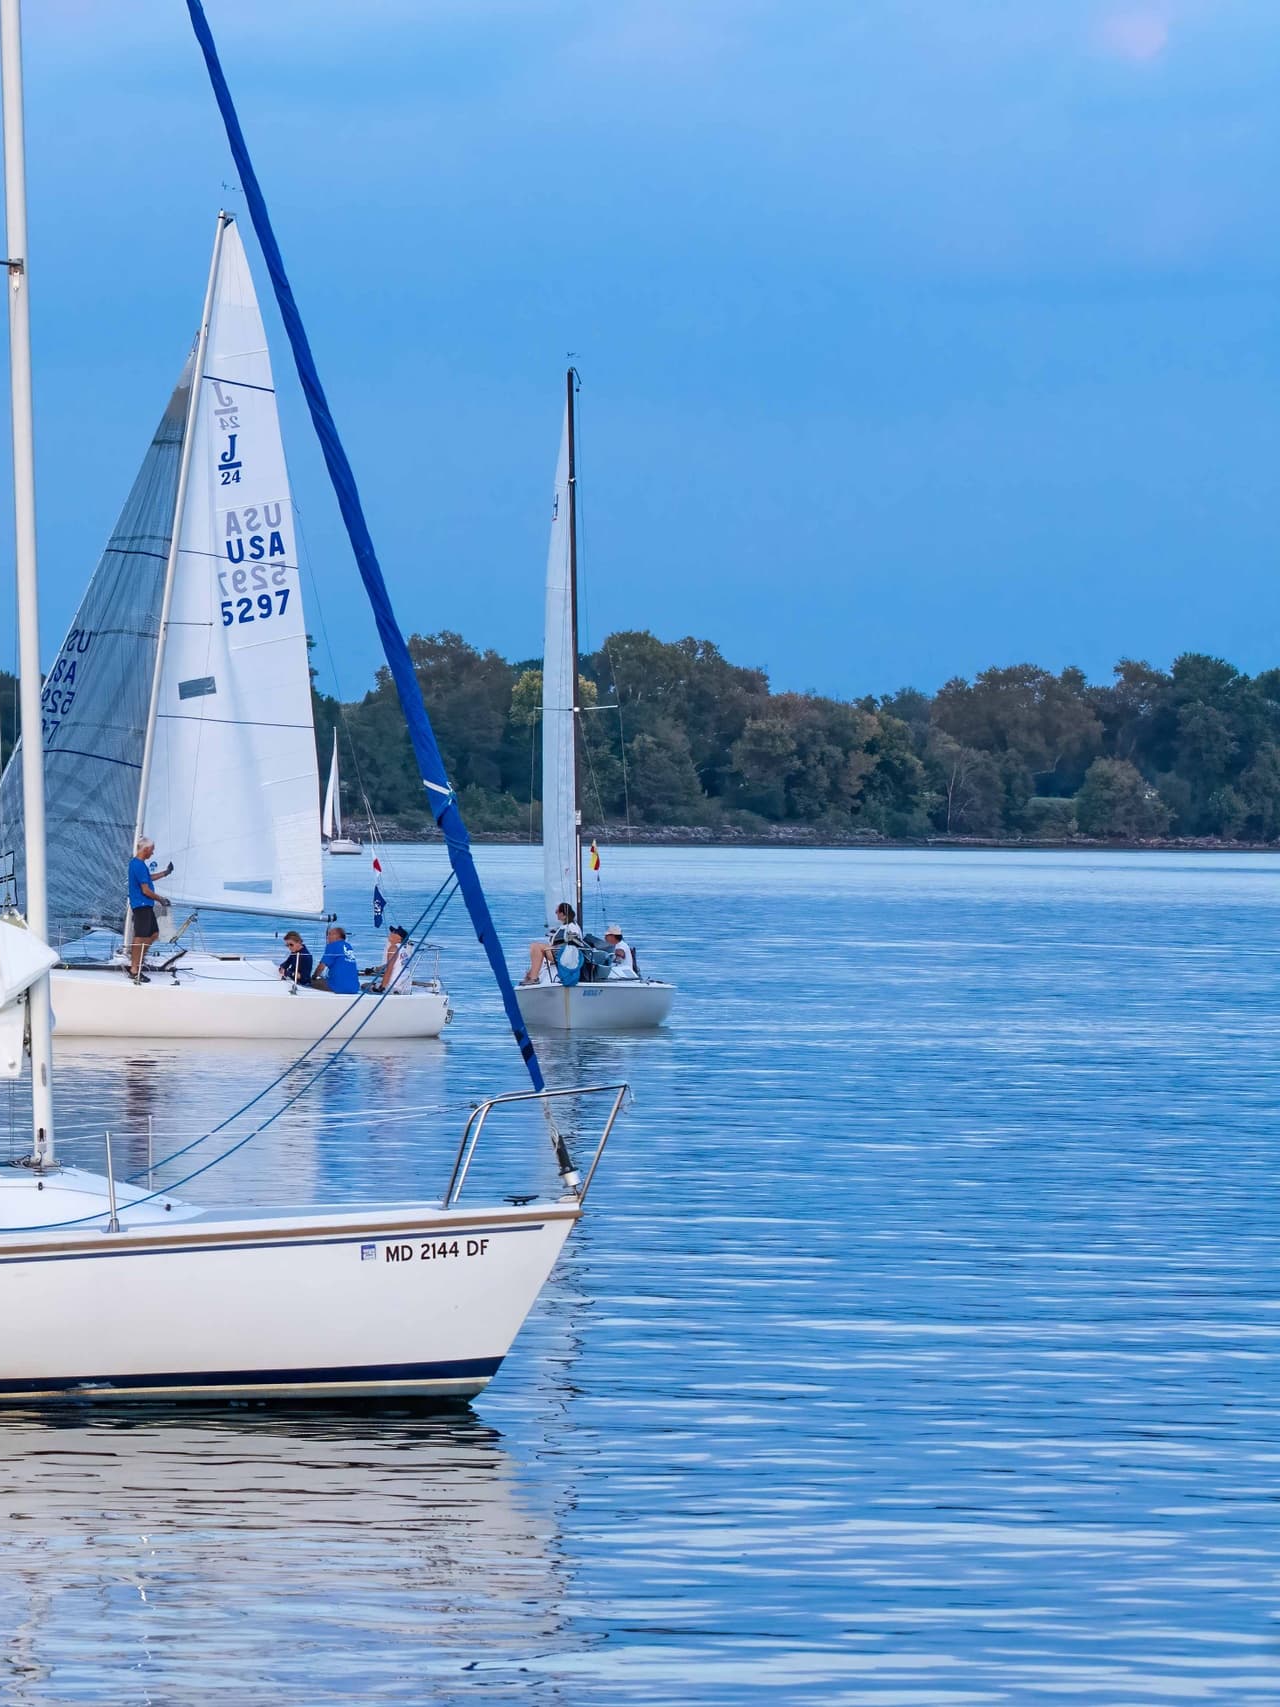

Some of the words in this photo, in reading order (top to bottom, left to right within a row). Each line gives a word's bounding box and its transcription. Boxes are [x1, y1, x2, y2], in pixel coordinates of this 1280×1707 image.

[221, 433, 237, 462] J
[221, 470, 241, 485] 24
[226, 531, 285, 564] USA
[221, 589, 290, 626] 5297
[386, 1245, 413, 1262] MD
[420, 1241, 459, 1260] 2144
[467, 1239, 489, 1256] DF
